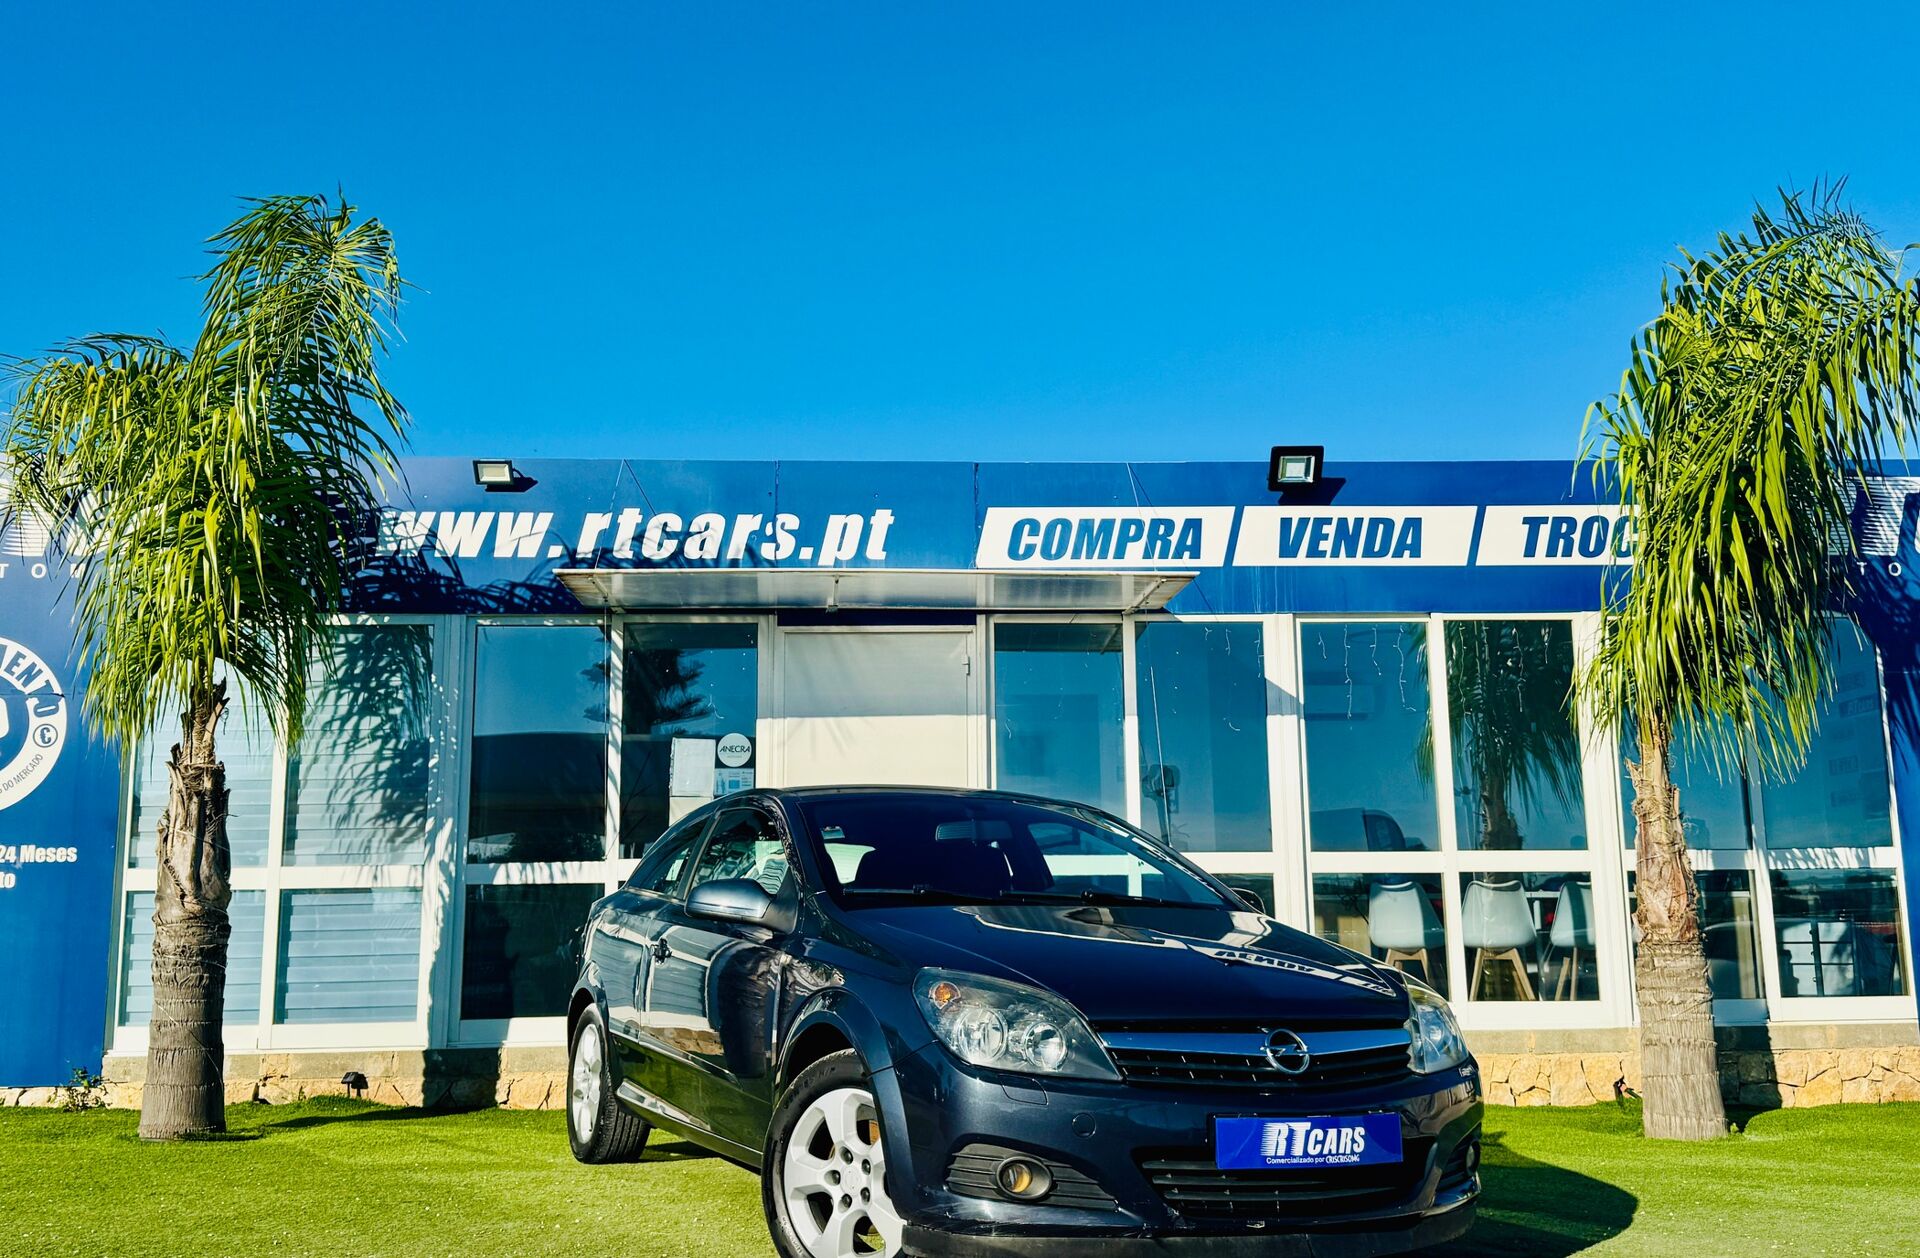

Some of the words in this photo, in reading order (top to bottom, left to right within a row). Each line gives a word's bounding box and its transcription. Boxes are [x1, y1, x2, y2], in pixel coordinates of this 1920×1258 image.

[376, 508, 895, 566] www.rtcars.pt
[1007, 517, 1203, 561] COMPRA
[1278, 517, 1422, 559] VENDA
[719, 745, 751, 753] ANECRA
[2, 779, 14, 791] DO
[13, 753, 43, 784] MERCADO
[20, 845, 78, 863] Meses
[1266, 1156, 1314, 1165] Comercializado
